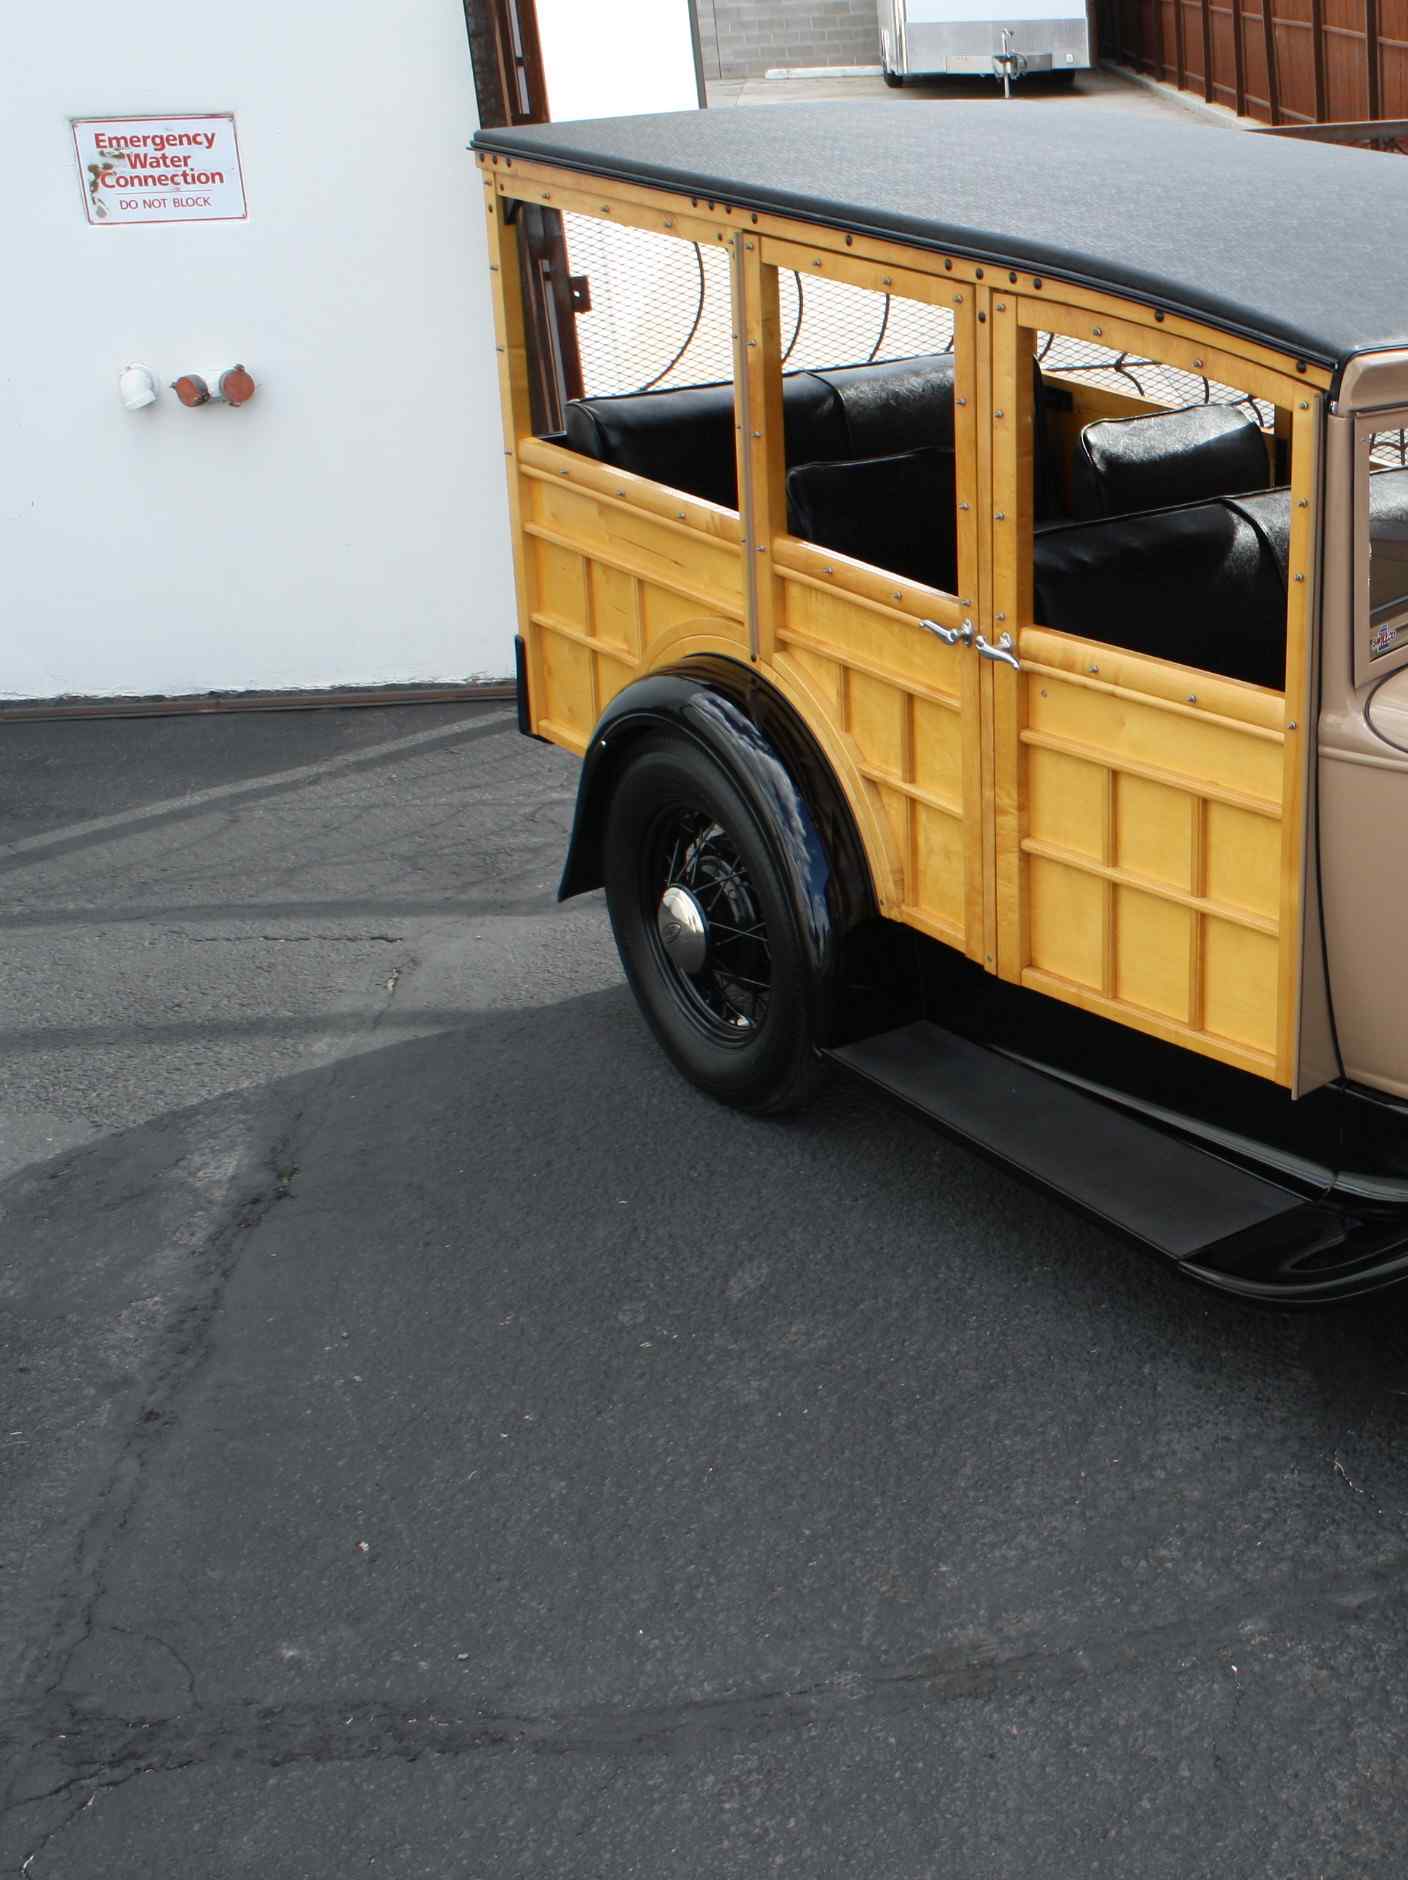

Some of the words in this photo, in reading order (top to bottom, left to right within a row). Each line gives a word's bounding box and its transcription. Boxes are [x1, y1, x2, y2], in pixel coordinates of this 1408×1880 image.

[94, 132, 216, 151] Emergency
[127, 153, 191, 169] Water
[101, 168, 224, 189] Connection
[119, 200, 138, 210] DO
[143, 199, 167, 209] NOT
[173, 197, 212, 208] BLOCK
